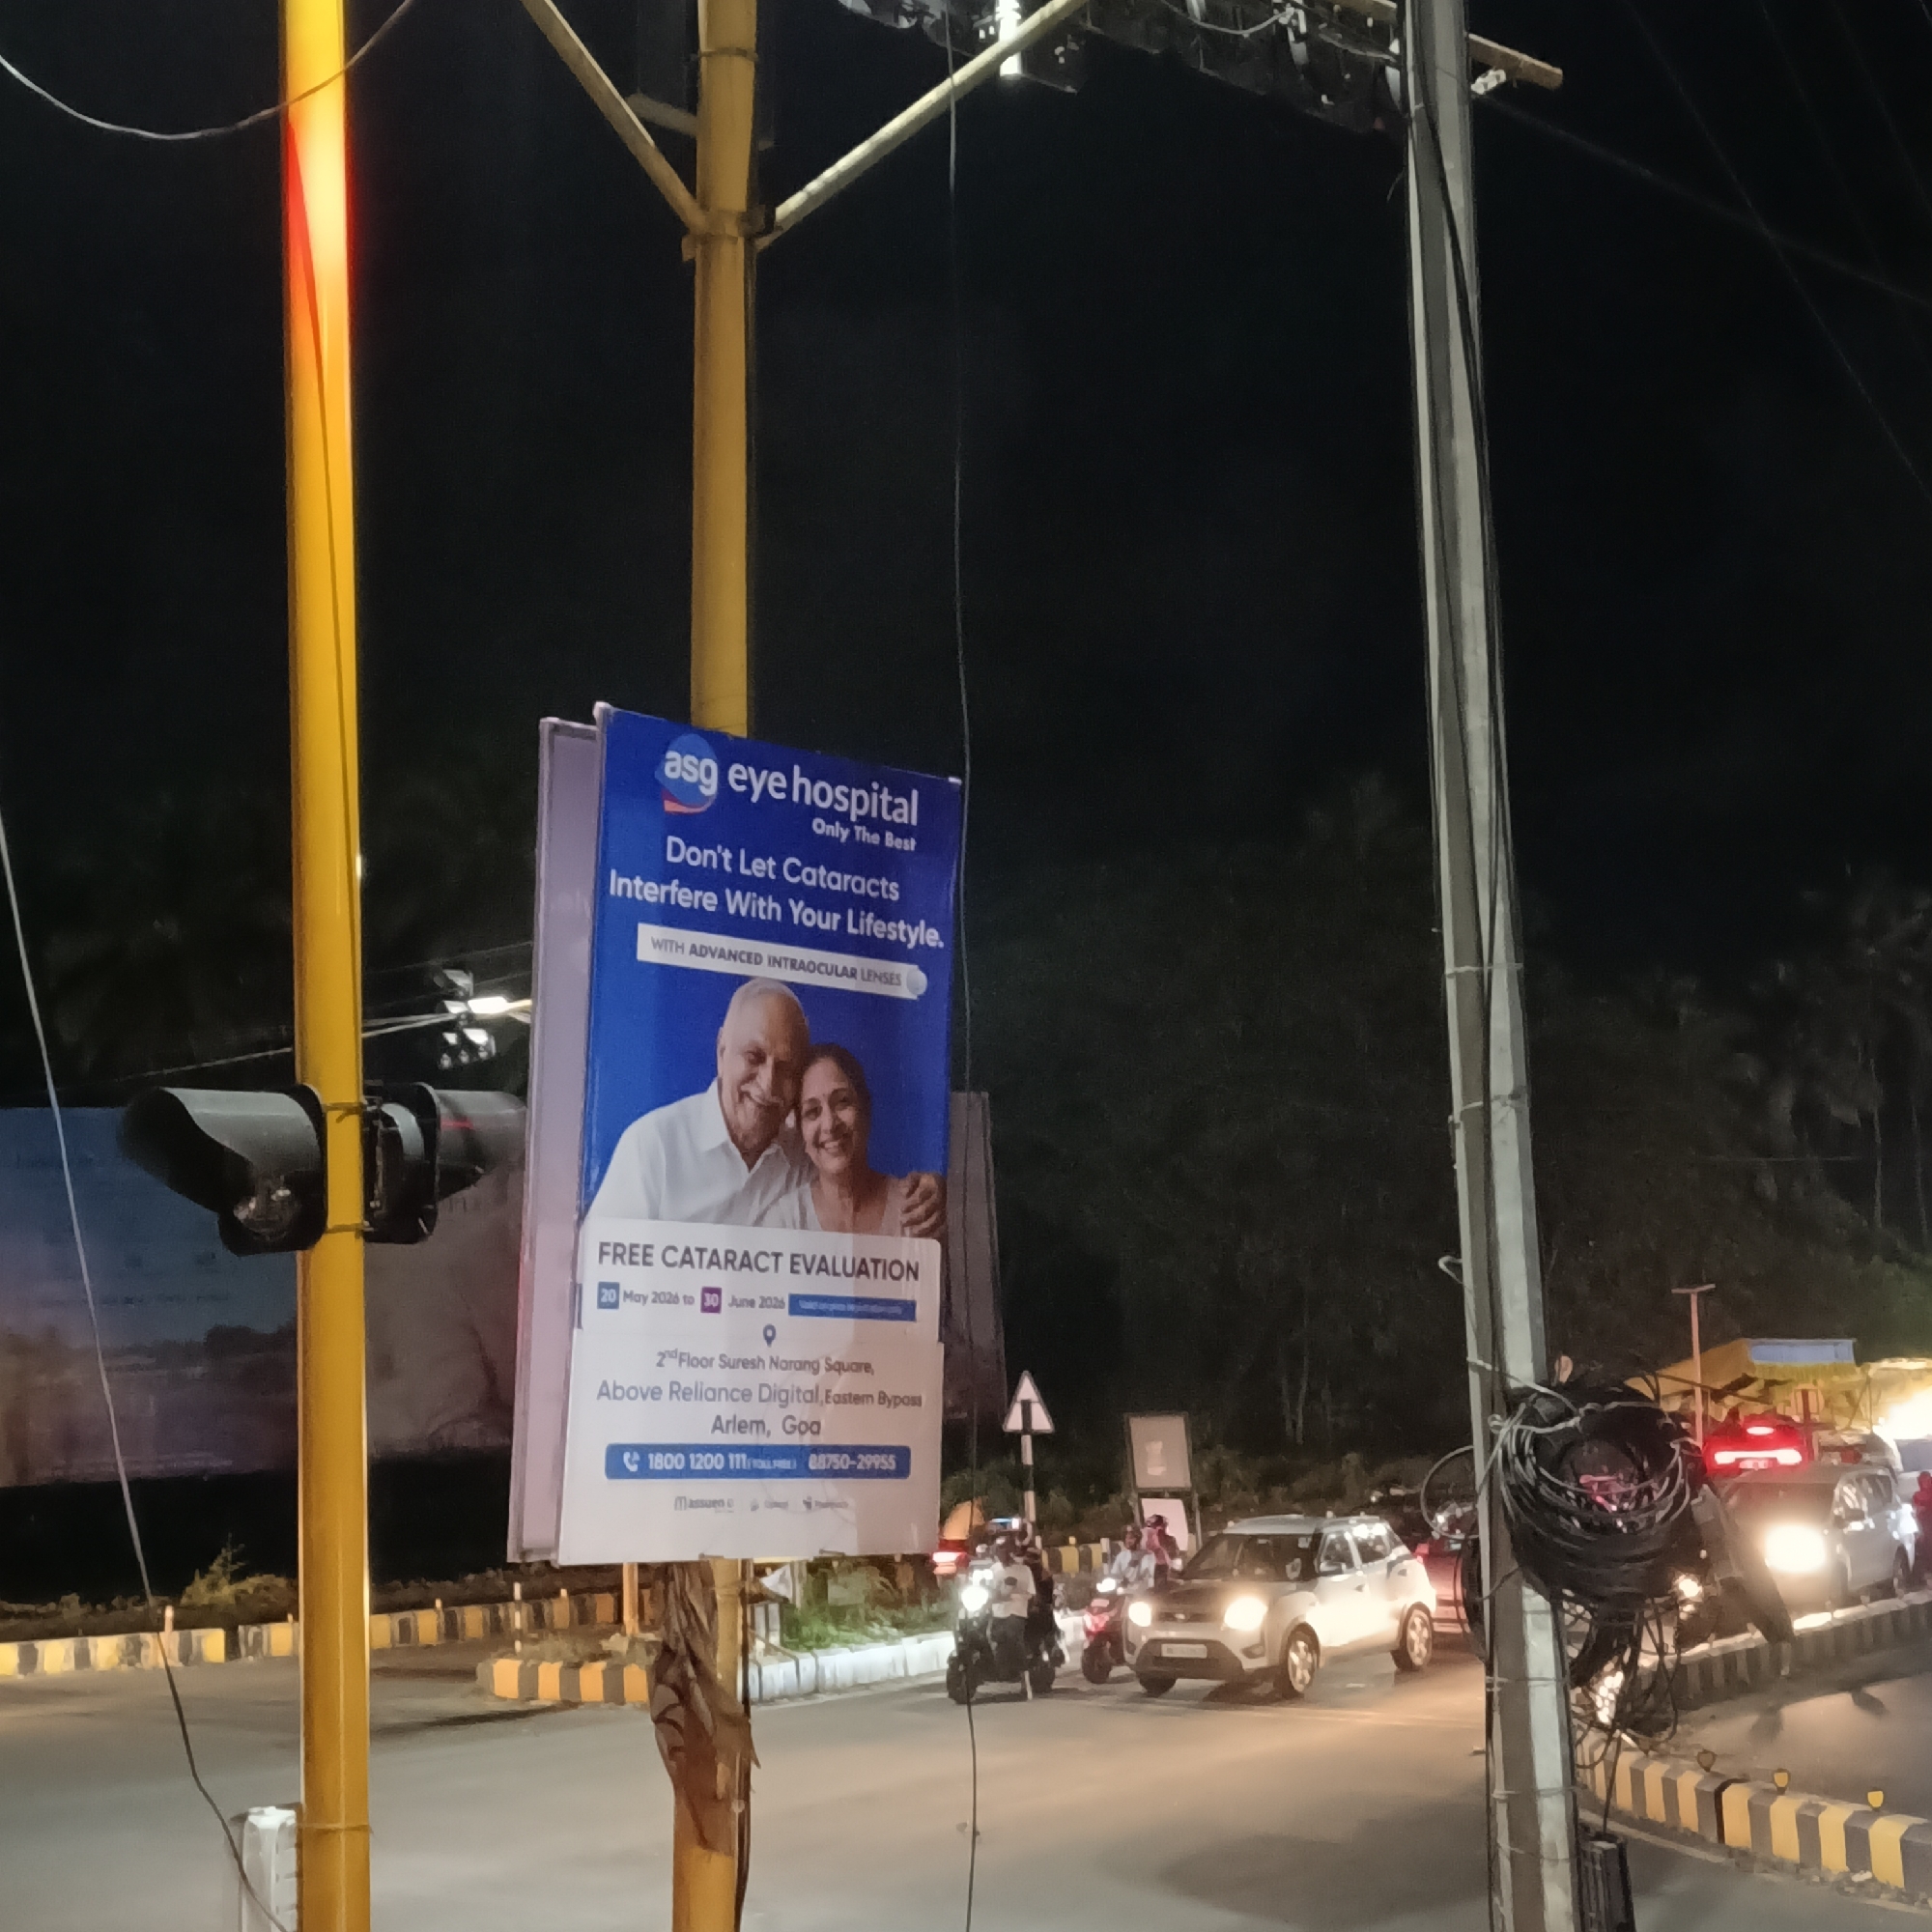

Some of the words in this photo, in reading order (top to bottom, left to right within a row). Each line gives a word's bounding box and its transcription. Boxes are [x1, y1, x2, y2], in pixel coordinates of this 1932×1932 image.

[664, 751, 718, 796] asg
[811, 817, 850, 843] Only
[854, 825, 880, 845] The
[885, 831, 917, 851] Best
[667, 836, 732, 872] Don't
[739, 848, 776, 879] Let
[783, 857, 899, 901] Cataracts
[610, 868, 718, 912] Interfere
[725, 888, 781, 922] With
[788, 898, 840, 931] Your
[847, 908, 944, 949] Lifestyle.
[651, 936, 685, 954] WITH
[689, 943, 763, 966] ADVANCED
[767, 954, 858, 979] INTRAOCULAR
[861, 968, 901, 986] LENSES
[598, 1241, 654, 1267] FREE
[661, 1245, 783, 1273] CATARACT
[790, 1254, 920, 1281] EVALUATION
[600, 1288, 617, 1303] 20
[623, 1290, 648, 1306] May
[651, 1291, 680, 1305] 2026
[682, 1293, 695, 1305] to
[704, 1293, 719, 1307] 30
[728, 1294, 755, 1309] June
[678, 1351, 715, 1368] Floor
[719, 1353, 765, 1370] Suresh
[769, 1355, 820, 1376] Narang
[824, 1356, 874, 1376] Square,
[596, 1379, 663, 1401] Above
[669, 1380, 753, 1403] Reliance
[877, 1390, 923, 1408] Bypass
[711, 1413, 771, 1437] Arlem,
[781, 1414, 821, 1435] Goa
[648, 1452, 685, 1470] 1800
[689, 1452, 724, 1470] 1200
[728, 1452, 747, 1469] 111
